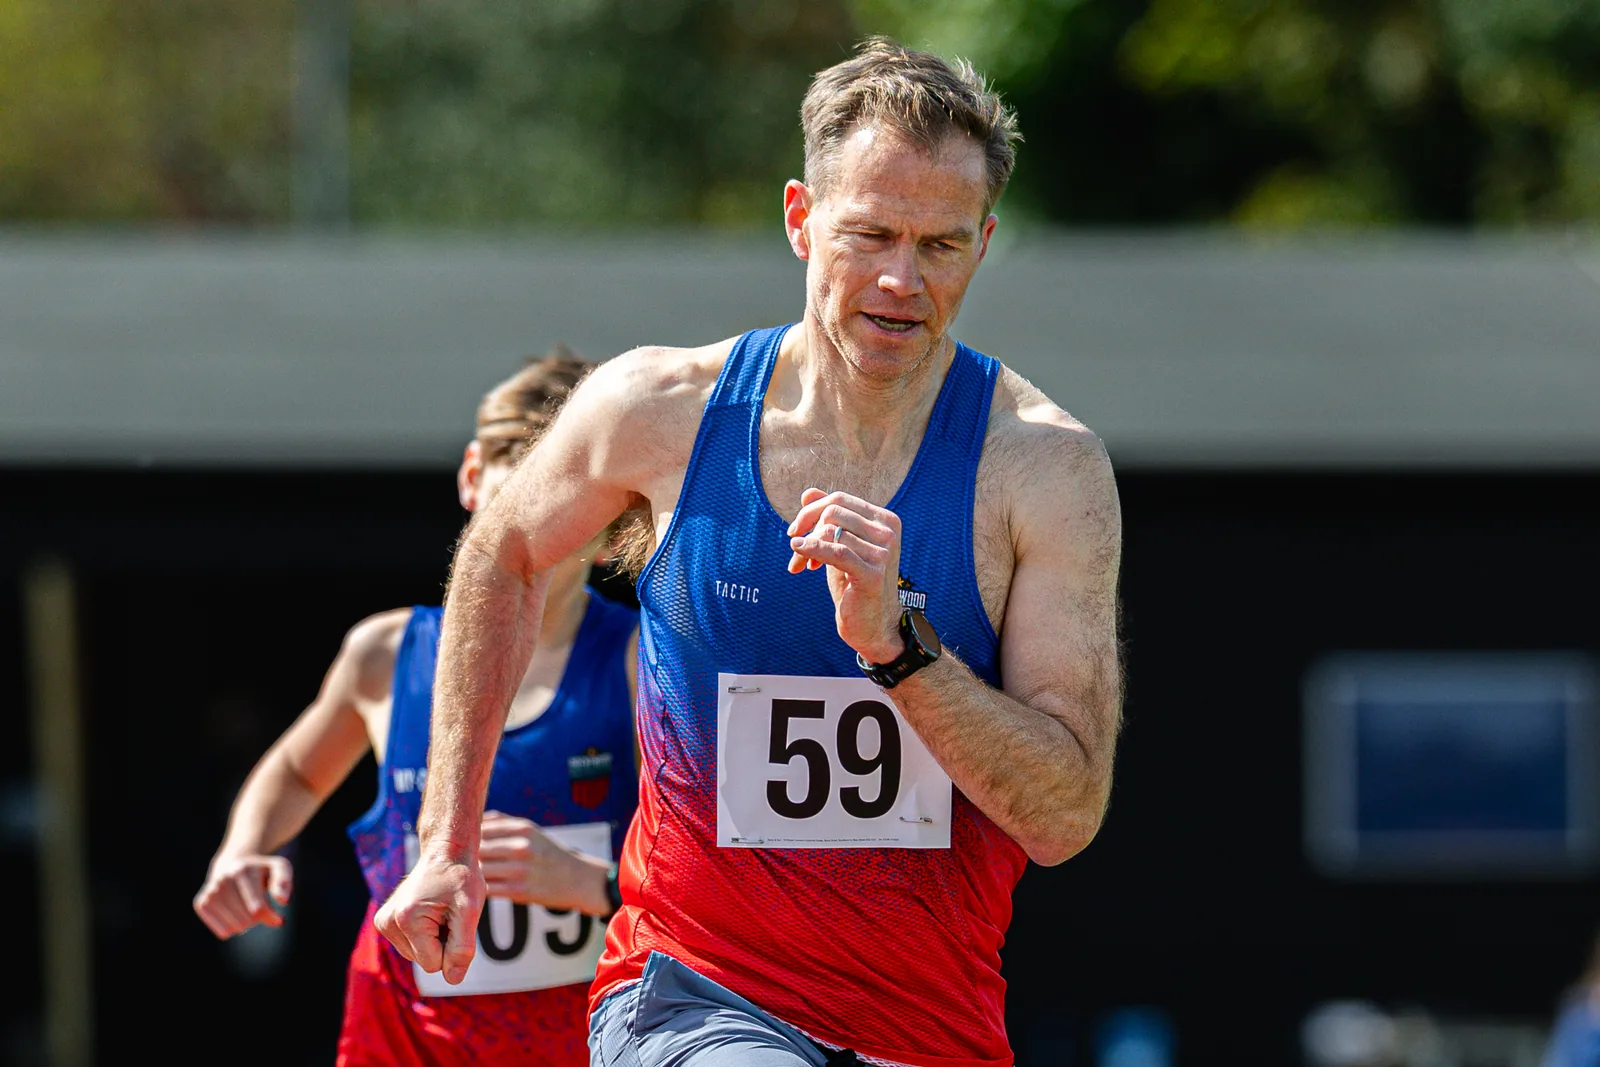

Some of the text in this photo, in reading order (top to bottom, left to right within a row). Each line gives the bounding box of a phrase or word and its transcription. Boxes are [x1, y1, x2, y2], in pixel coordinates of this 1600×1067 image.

[715, 580, 760, 604] TACTIC
[898, 589, 926, 610] WOOD
[766, 698, 902, 819] 59
